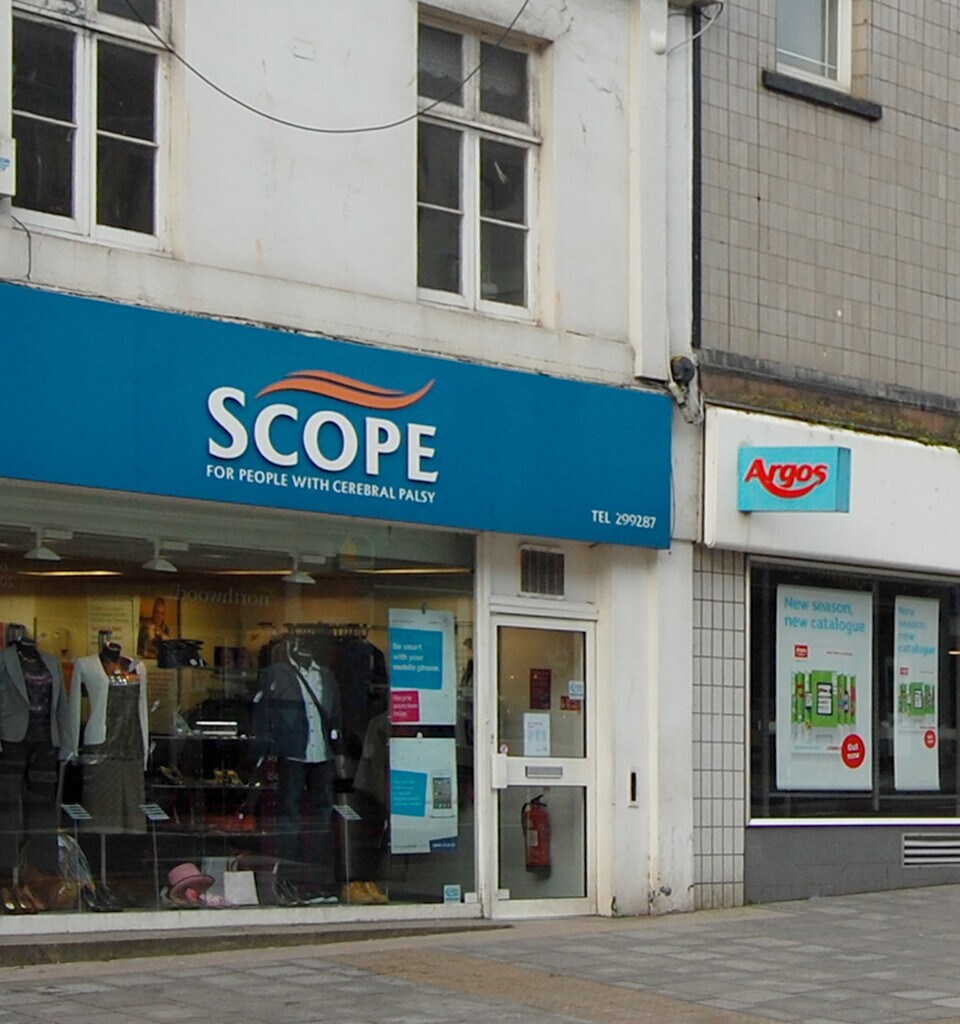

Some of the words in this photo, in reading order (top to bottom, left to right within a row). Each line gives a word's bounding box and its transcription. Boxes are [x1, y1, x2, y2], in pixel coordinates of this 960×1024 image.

[207, 386, 439, 483] SCOPE
[206, 464, 235, 480] FOR
[239, 469, 288, 487] PEOPLE
[292, 474, 330, 491] WITH
[333, 479, 396, 500] CEREBRAL
[399, 488, 436, 504] PALSY
[743, 457, 829, 499] Argos
[591, 509, 611, 524] TEL
[615, 512, 656, 529] 299287
[784, 597, 808, 610] New
[812, 600, 853, 615] season,
[784, 616, 807, 627] new
[811, 617, 865, 635] catalogue
[408, 654, 424, 662] your
